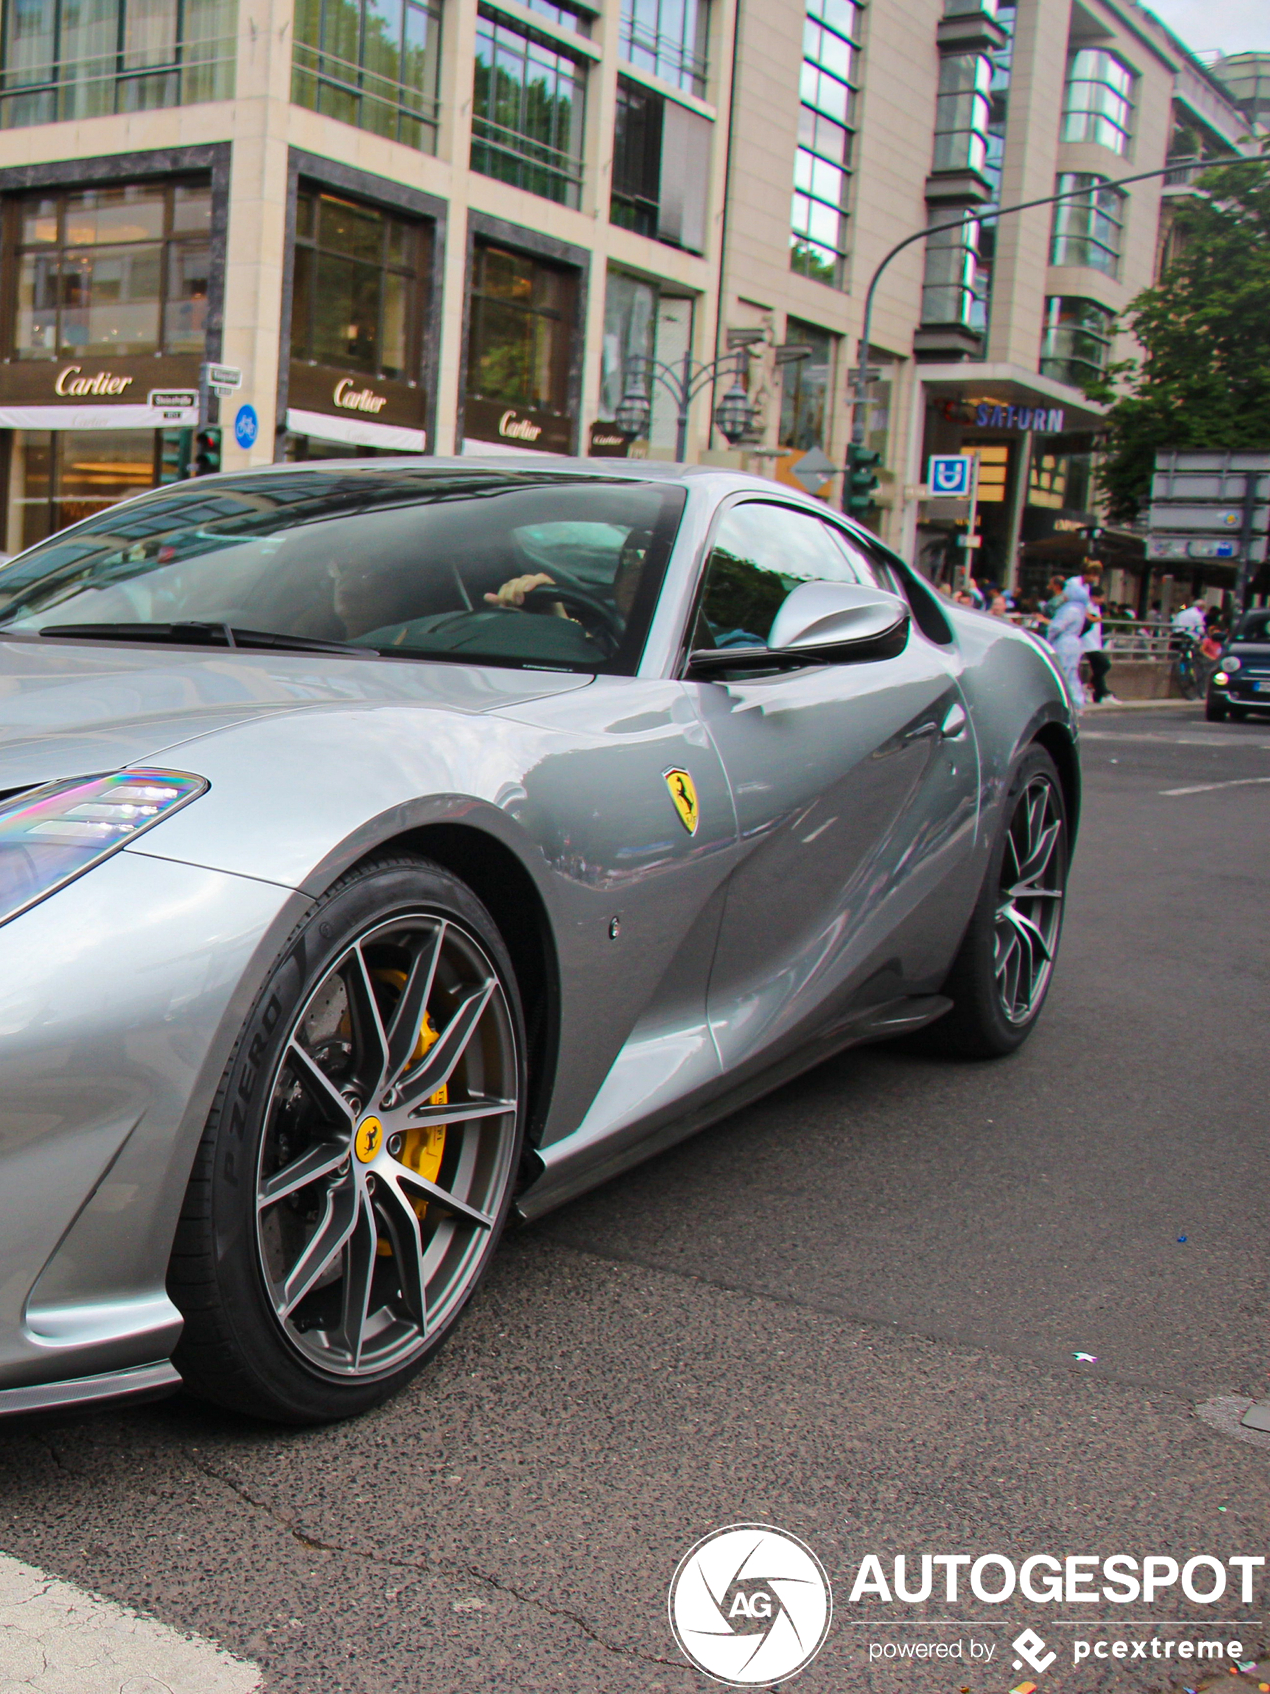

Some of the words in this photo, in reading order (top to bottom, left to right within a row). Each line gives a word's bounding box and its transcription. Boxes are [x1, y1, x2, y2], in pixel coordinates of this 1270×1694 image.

[55, 366, 133, 397] Cartier
[333, 378, 387, 414] Cartier
[498, 409, 542, 442] Cartier
[976, 403, 1065, 433] SATURN
[592, 434, 624, 446] Cartier
